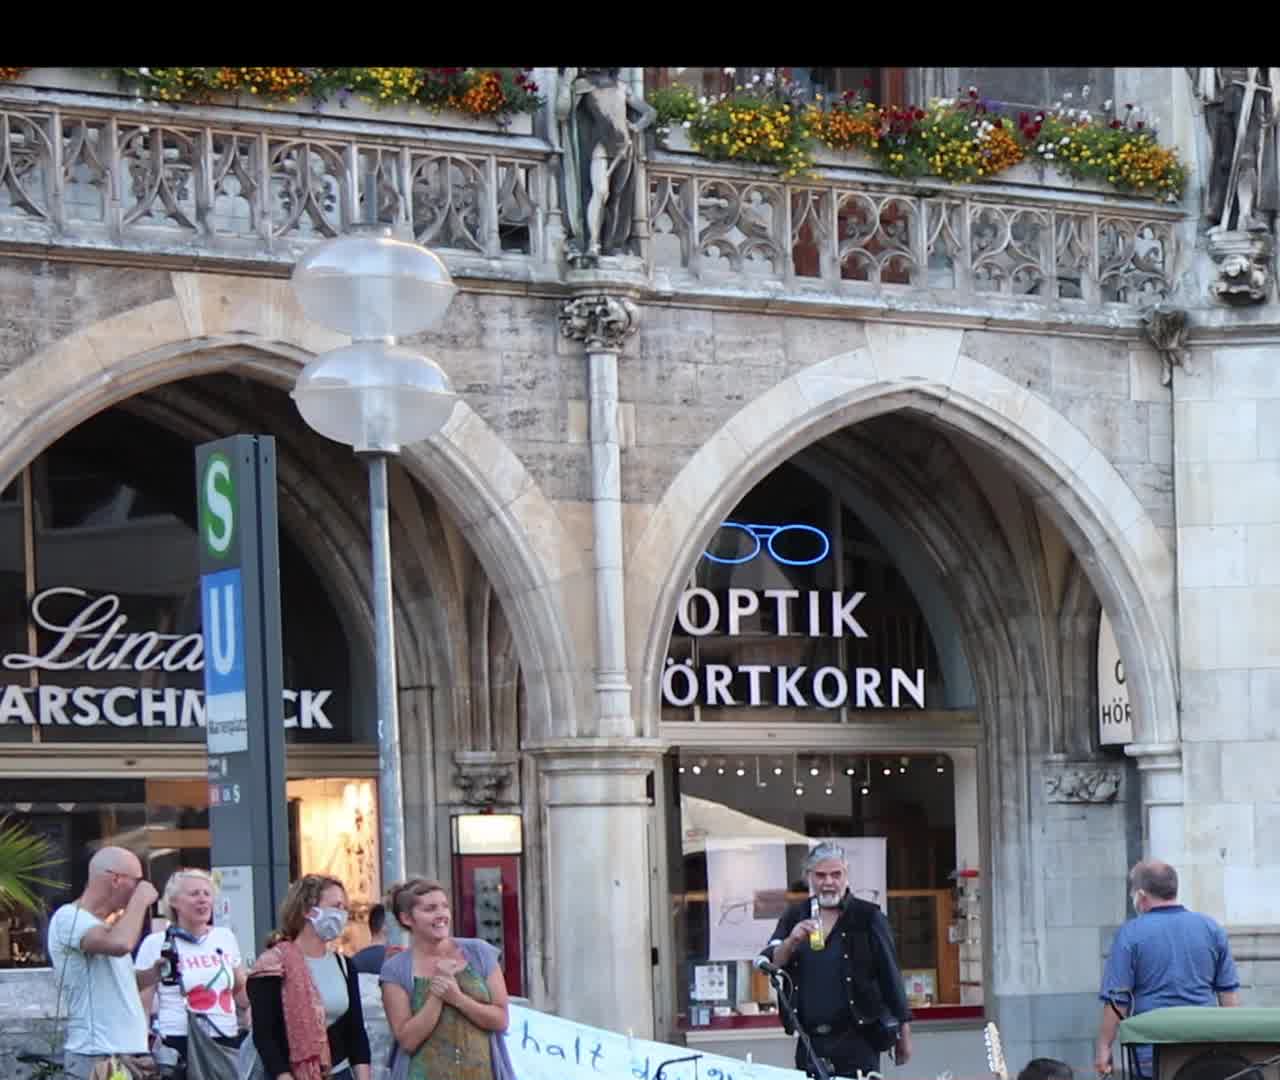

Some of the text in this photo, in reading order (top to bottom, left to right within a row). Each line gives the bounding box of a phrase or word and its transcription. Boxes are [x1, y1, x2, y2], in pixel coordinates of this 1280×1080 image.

[207, 460, 234, 552] S
[208, 584, 236, 676] U
[678, 587, 868, 638] OPTIK
[662, 657, 925, 709] ÖRTKORN
[1102, 697, 1131, 725] HÖR
[522, 1021, 604, 1072] halt
